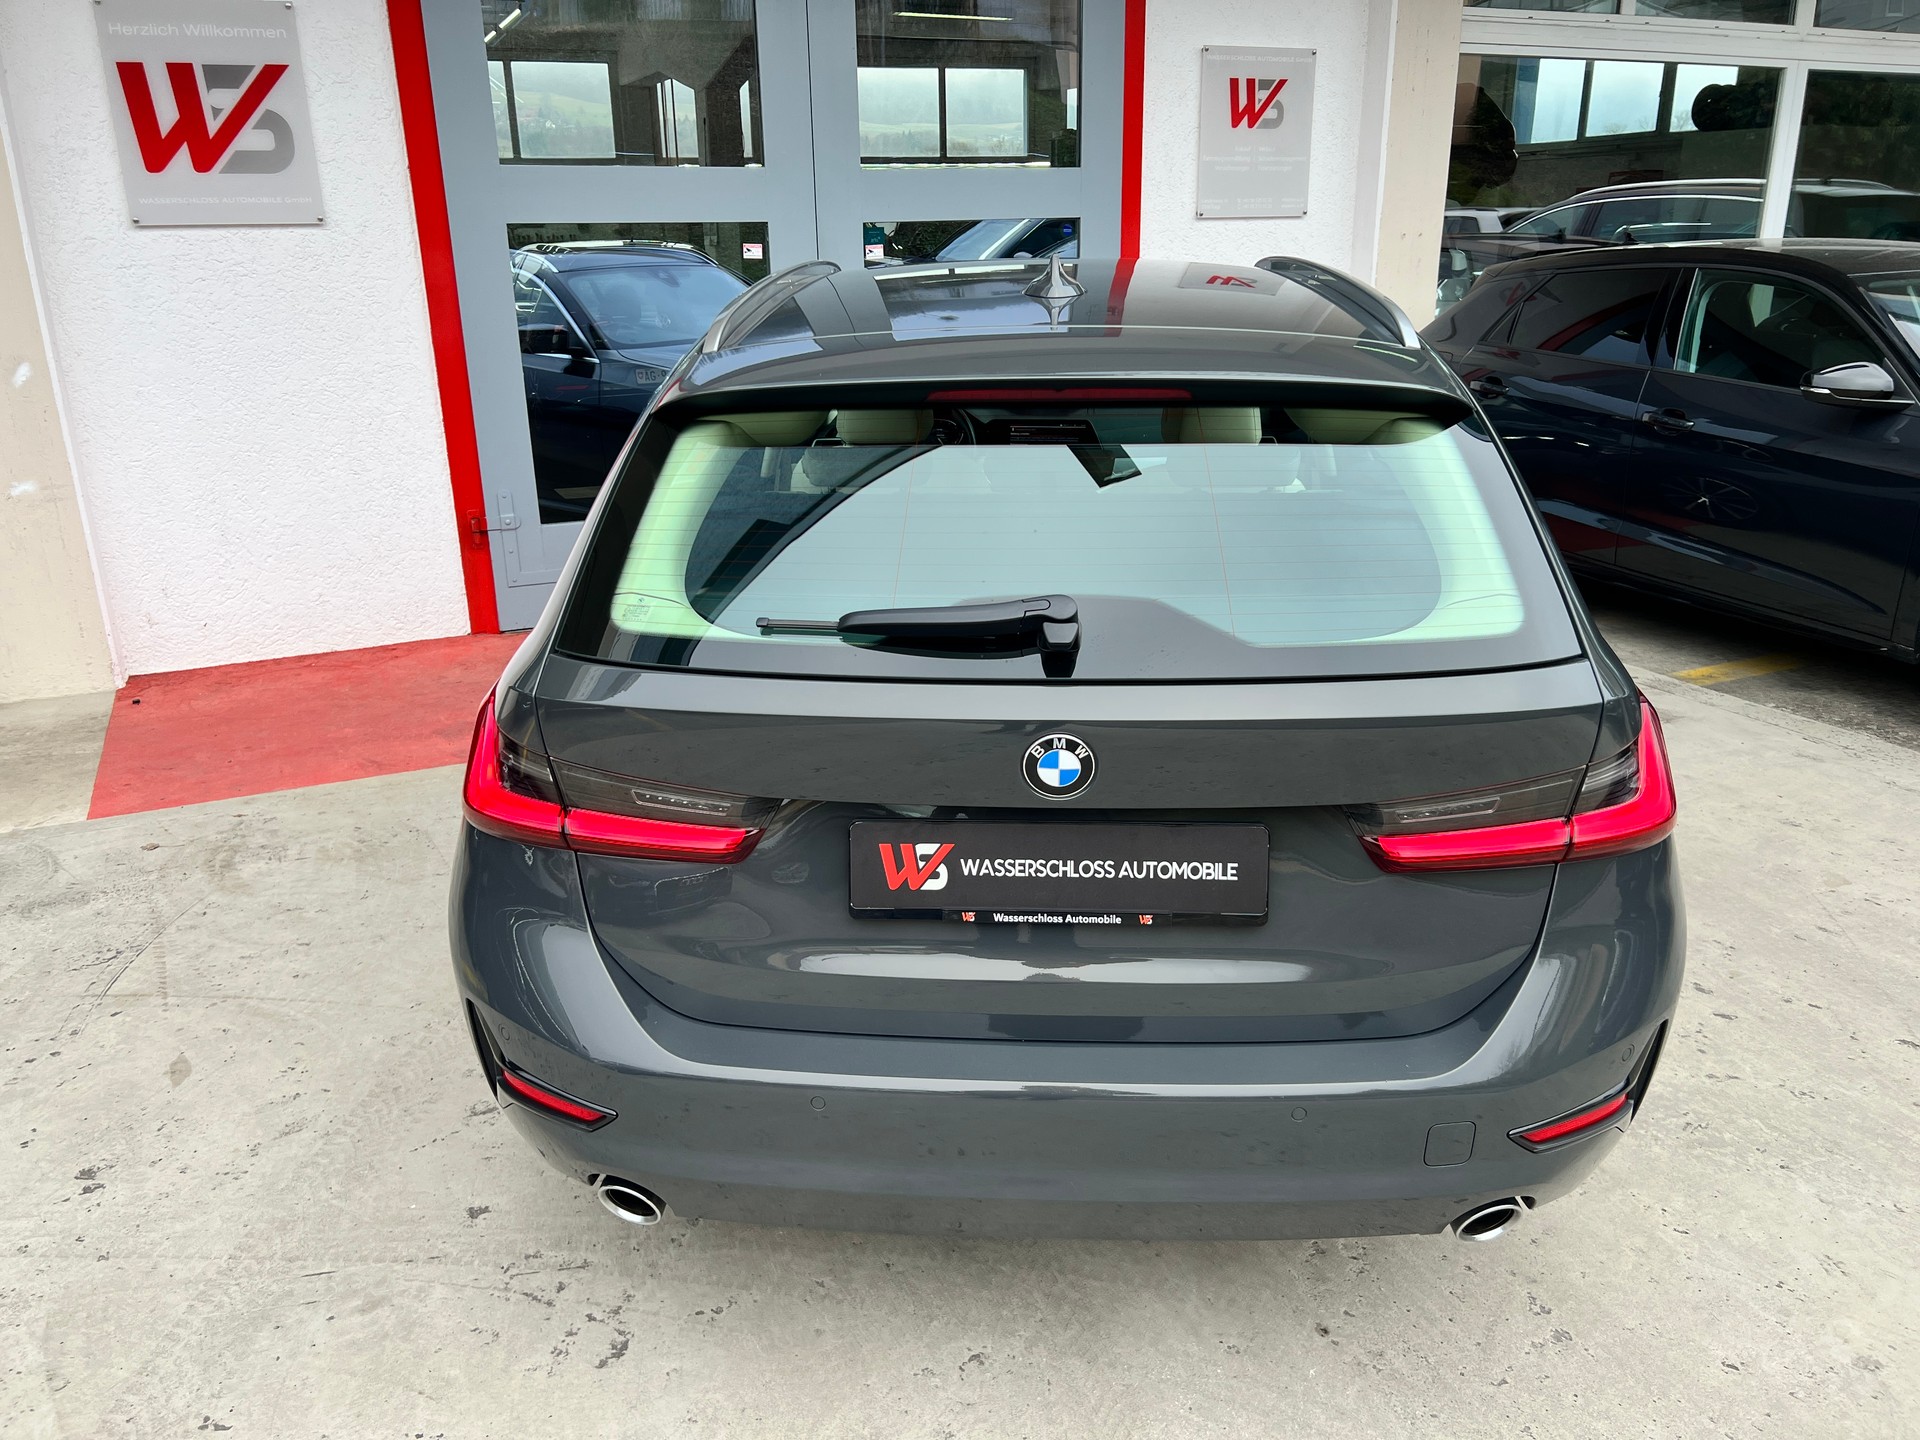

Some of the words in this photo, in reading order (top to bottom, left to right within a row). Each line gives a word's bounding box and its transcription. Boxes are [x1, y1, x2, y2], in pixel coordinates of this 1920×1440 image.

[108, 23, 180, 38] Herzlich
[182, 23, 287, 39] Willkommen
[1030, 737, 1089, 759] BMW
[960, 858, 1116, 879] WASSERSCHLOSS
[1118, 860, 1239, 881] AUTOMOBILE
[993, 912, 1063, 923] Wasserschloss
[1065, 914, 1122, 924] Automobile
